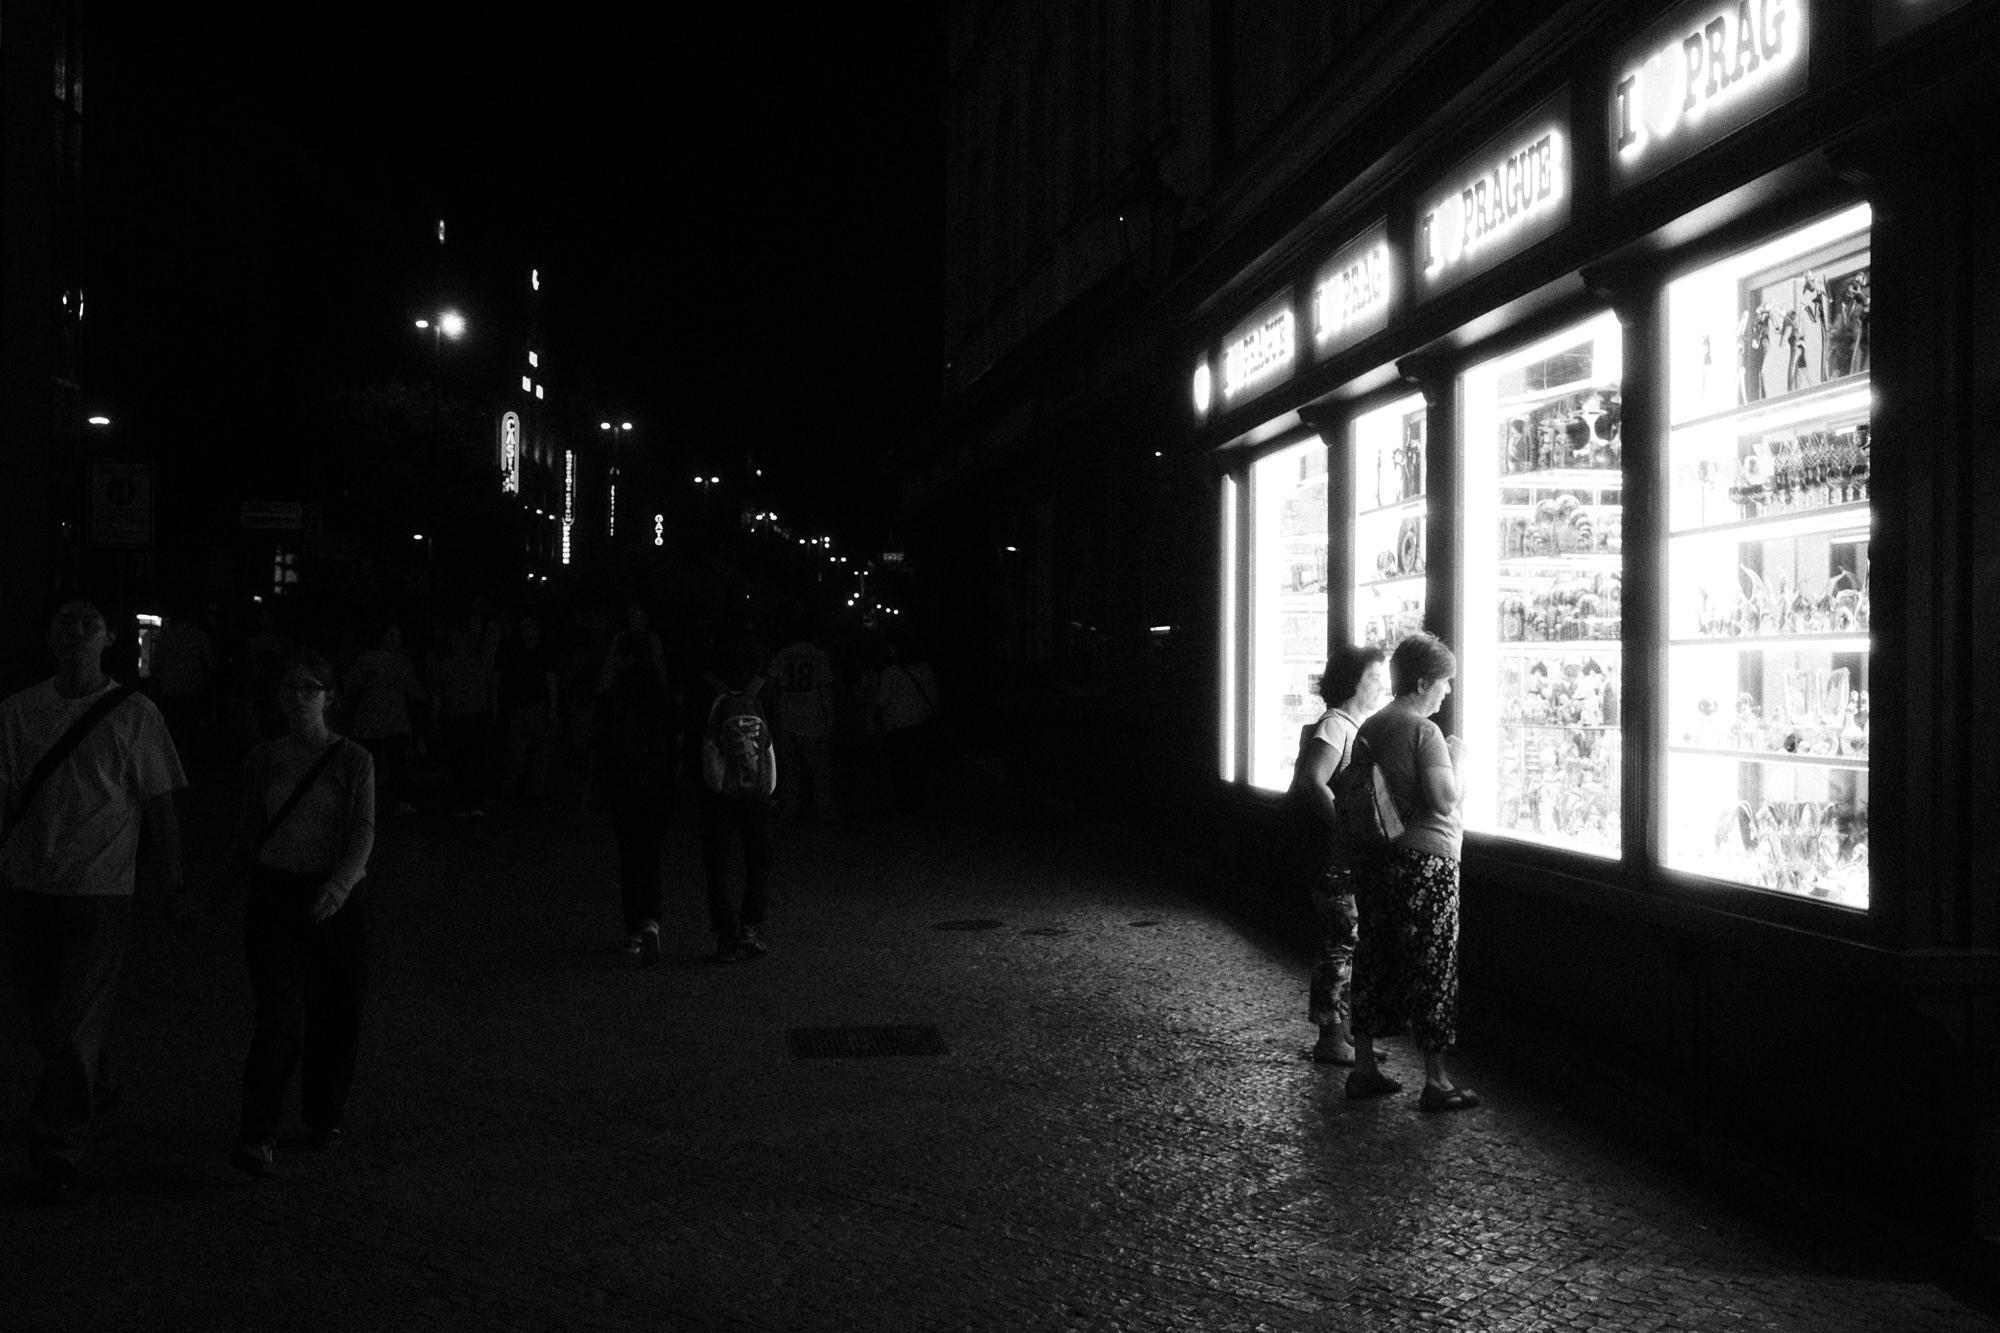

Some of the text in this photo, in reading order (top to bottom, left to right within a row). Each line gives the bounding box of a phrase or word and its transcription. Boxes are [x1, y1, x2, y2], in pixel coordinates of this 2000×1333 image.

[1616, 0, 1787, 153] I PRAG
[1424, 134, 1552, 270] I PRAGUE
